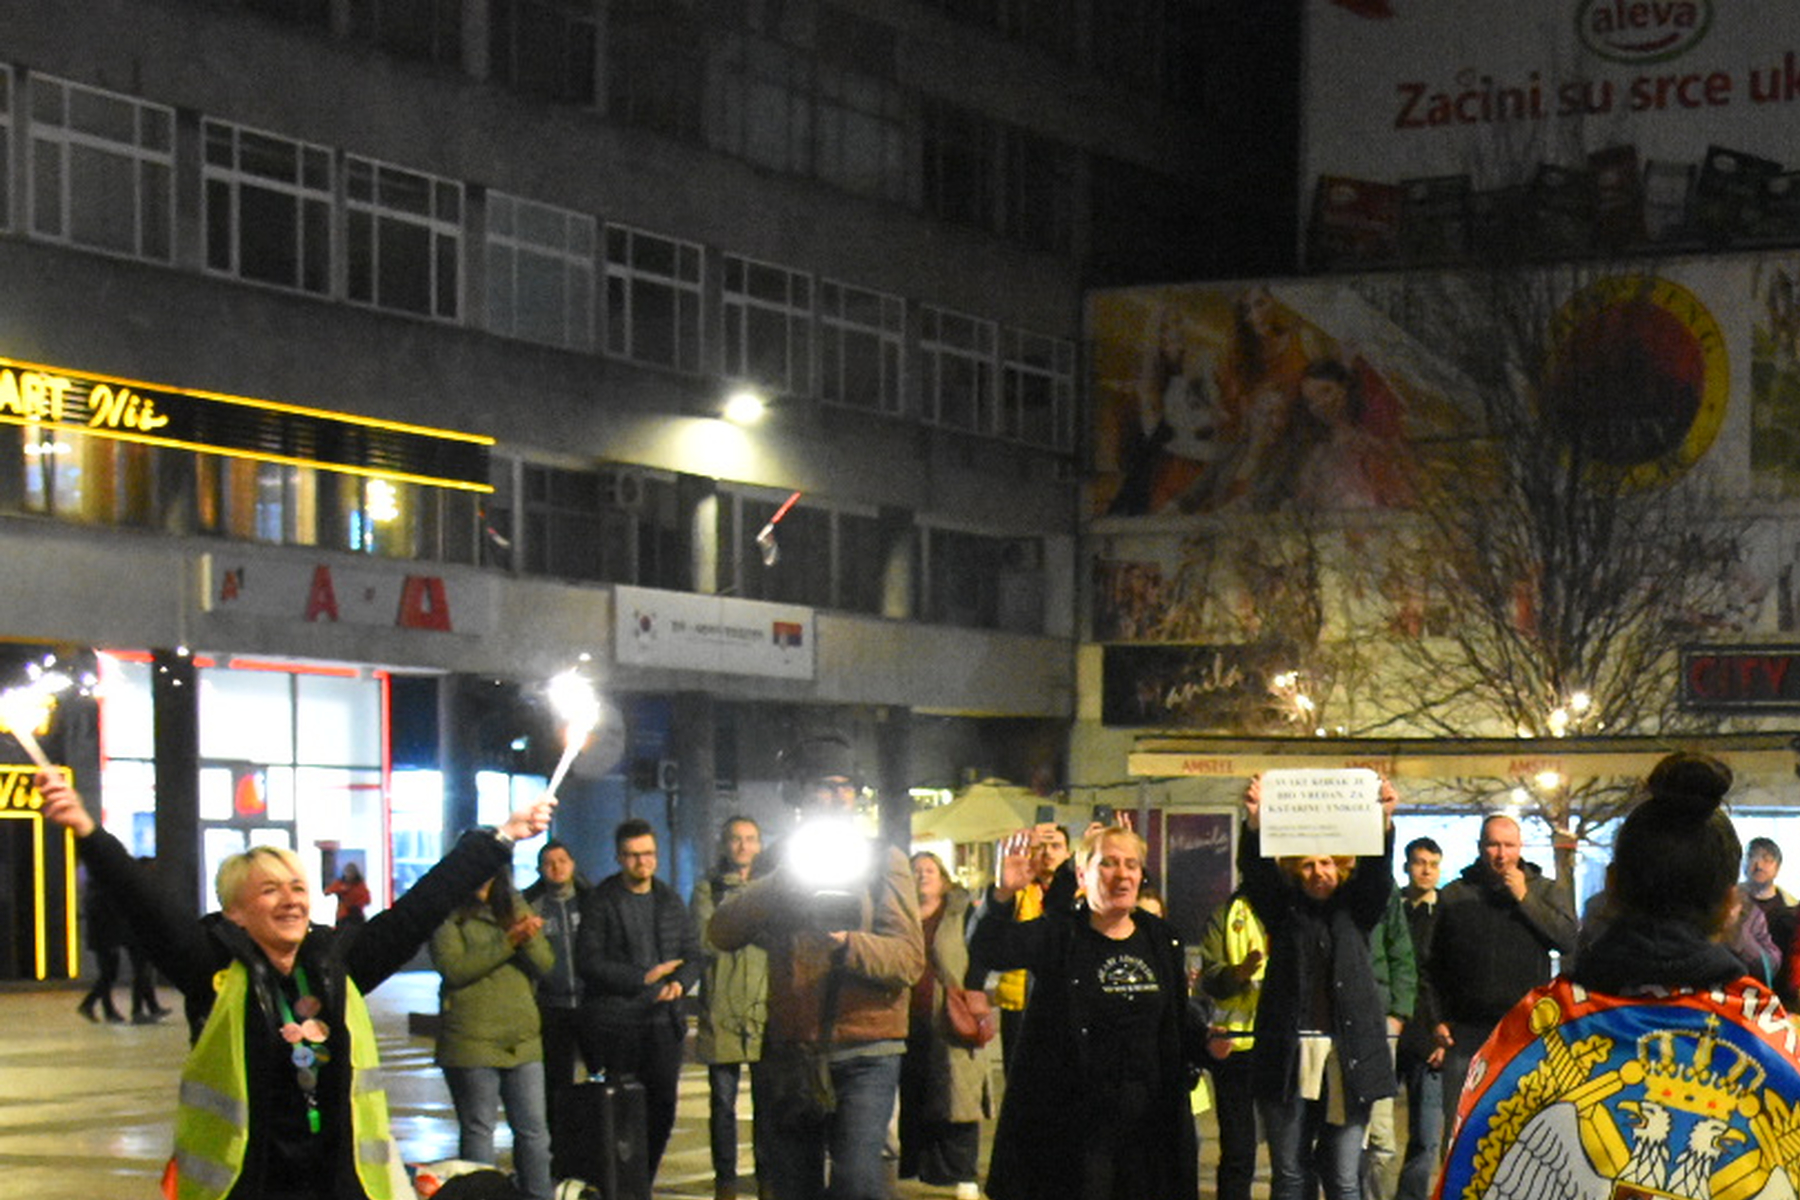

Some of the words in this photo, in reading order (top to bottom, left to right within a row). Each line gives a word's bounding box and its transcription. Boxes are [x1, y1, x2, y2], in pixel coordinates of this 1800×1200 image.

[1593, 0, 1698, 34] aleva
[1394, 66, 1543, 130] Začini
[1557, 80, 1613, 117] su
[1629, 70, 1733, 114] srce
[1690, 655, 1792, 697] CITY
